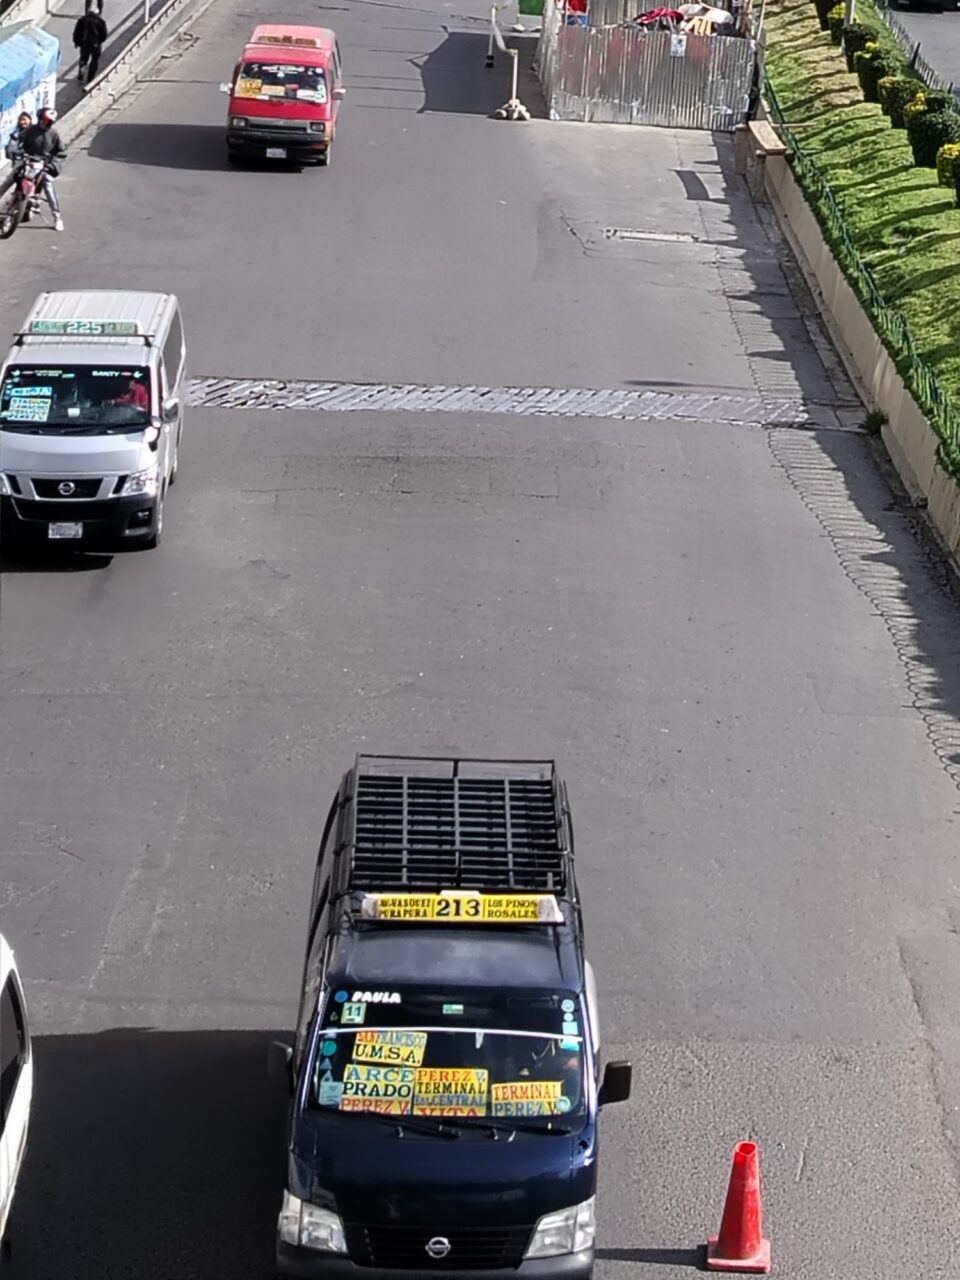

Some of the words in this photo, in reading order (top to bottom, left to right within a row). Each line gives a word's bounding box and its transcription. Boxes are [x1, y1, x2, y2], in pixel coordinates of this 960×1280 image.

[66, 321, 102, 334] 225
[435, 899, 480, 917] 213
[505, 899, 538, 908] PINOS
[487, 909, 538, 918] ROSALES
[351, 991, 402, 1003] PAULA
[345, 1006, 362, 1017] 11
[347, 1065, 415, 1082] ARCE
[418, 1070, 473, 1082] PEREZ
[342, 1081, 412, 1098] PRADO
[417, 1082, 486, 1095] TERMINAL
[493, 1083, 560, 1101] TERMINAL
[341, 1098, 392, 1113] PEREZ
[494, 1101, 544, 1116] PEREZ
